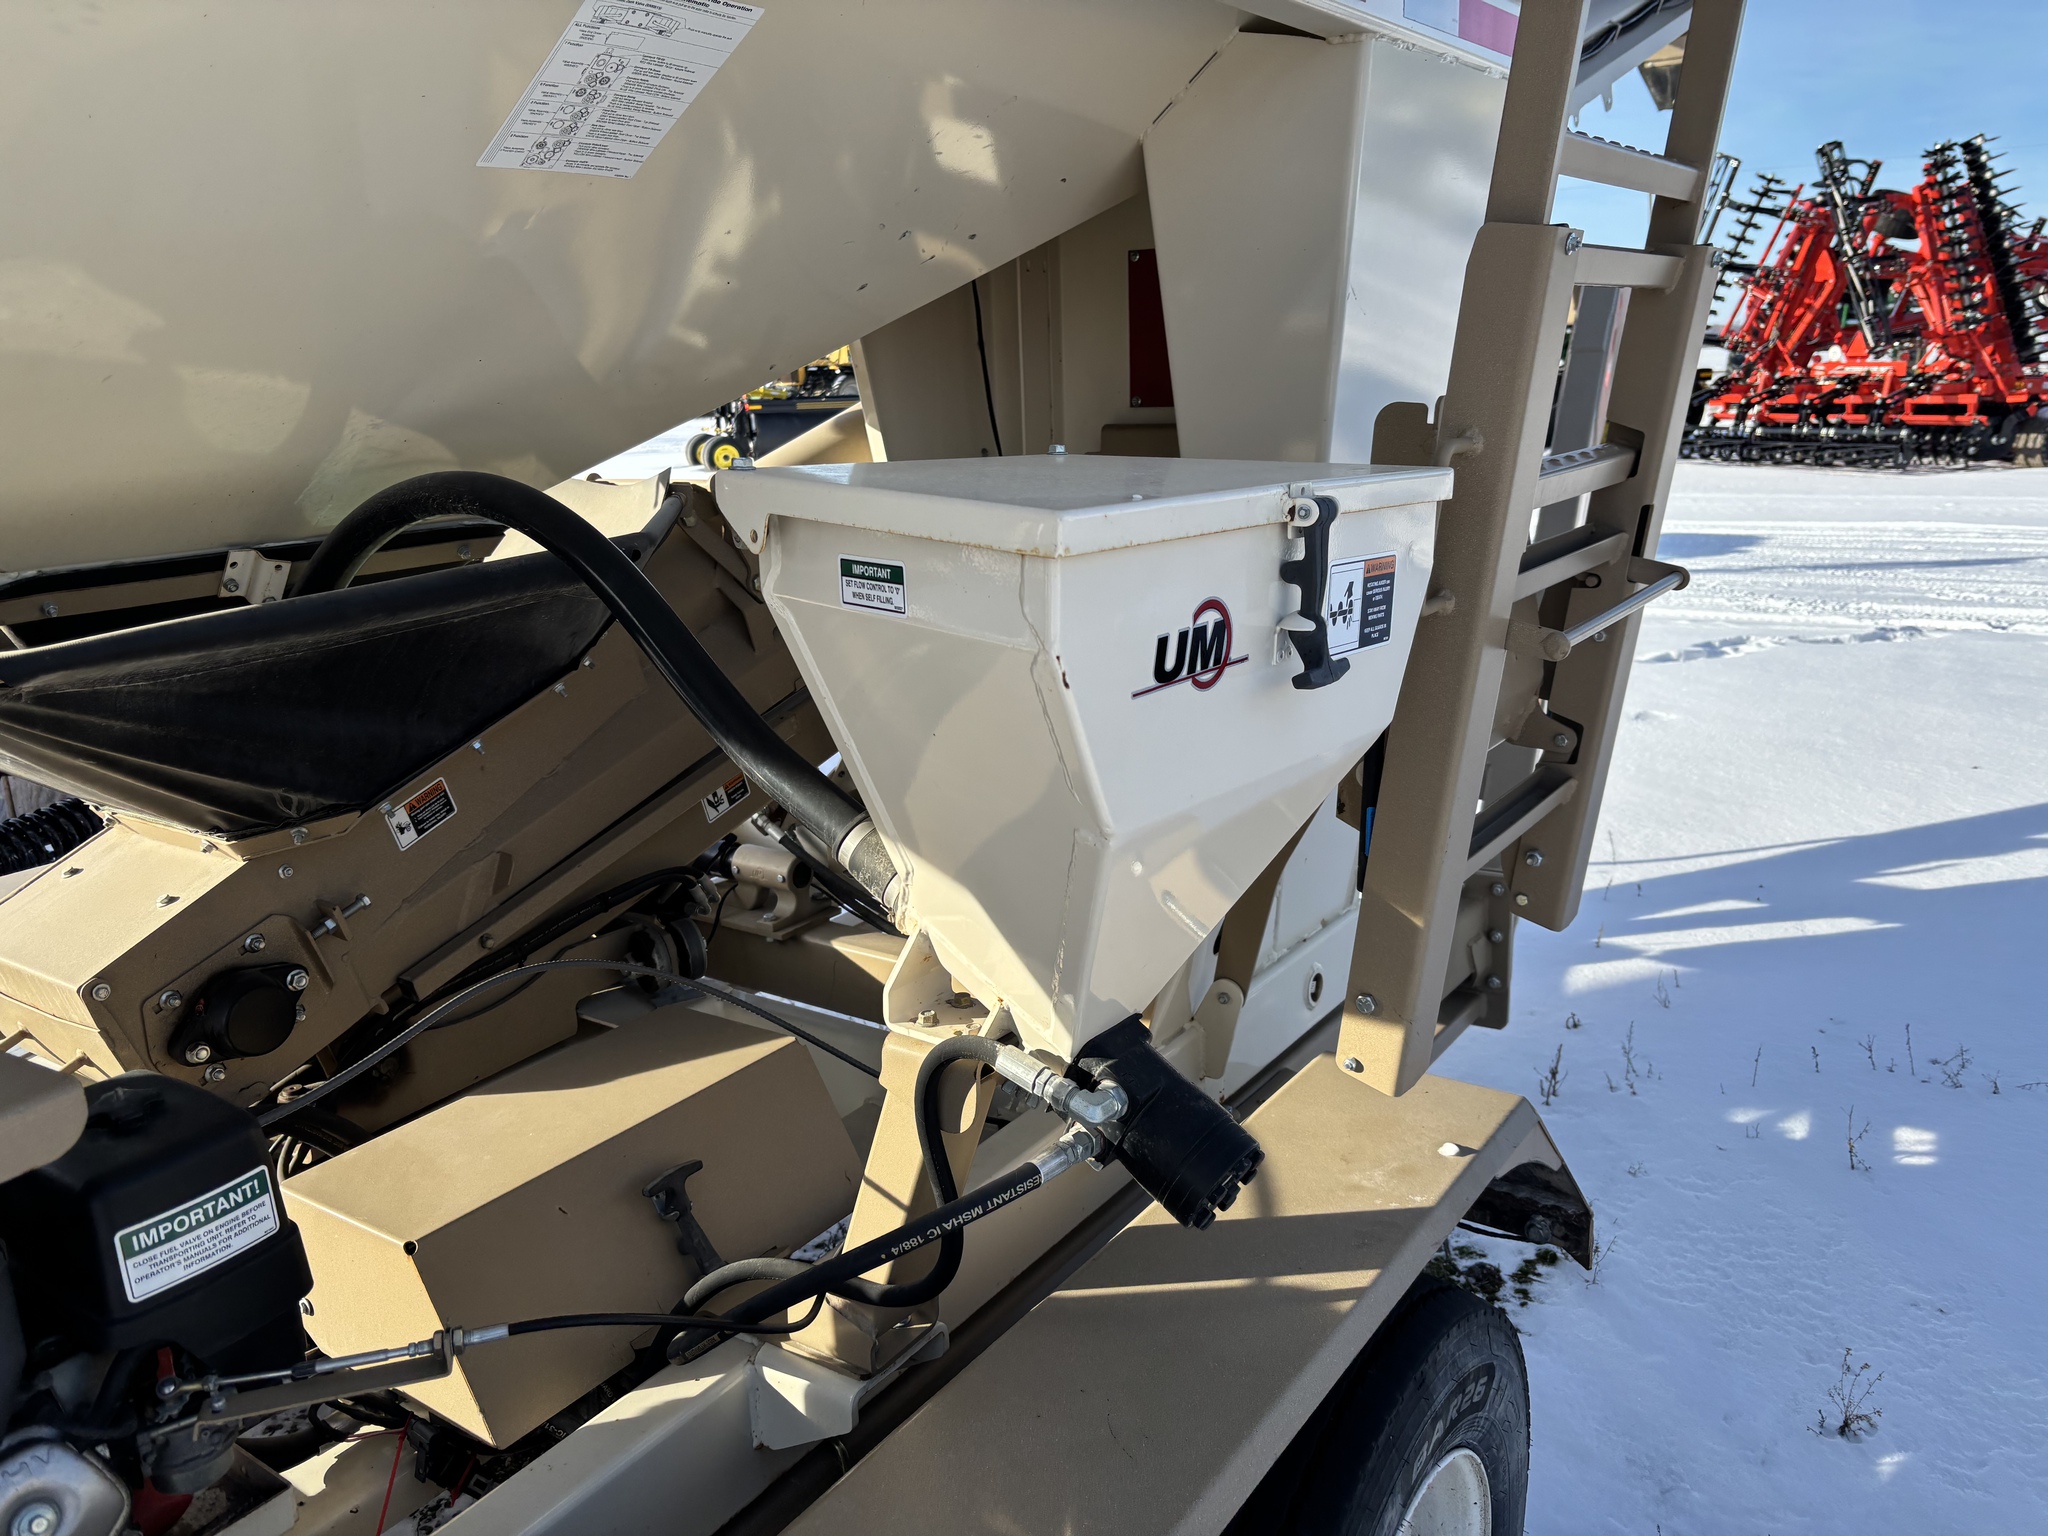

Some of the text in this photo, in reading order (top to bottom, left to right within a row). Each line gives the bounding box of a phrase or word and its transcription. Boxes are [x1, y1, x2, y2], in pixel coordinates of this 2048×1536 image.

[722, 1, 753, 13] Operation
[851, 563, 891, 579] IMPORTANT
[1370, 559, 1395, 573] WARNING
[845, 579, 853, 588] SET
[854, 579, 866, 590] FLOW
[866, 582, 887, 594] CONTROL
[887, 585, 895, 594] TO
[852, 591, 895, 606] WHEN SELF FILLING.
[1154, 618, 1227, 684] UM
[415, 783, 443, 806] WARNING
[131, 1179, 260, 1252] IMPORTANT!
[942, 1208, 983, 1231] MSHA
[133, 1200, 267, 1269] CLOSE FUEL VALVE ON ENGINE BEFORE
[148, 1240, 206, 1270] TRANSPORTING
[225, 1220, 247, 1235] REFER
[248, 1214, 257, 1225] TO
[926, 1227, 942, 1240] IC
[134, 1213, 272, 1285] OPERATOR'S MANUALS FOR ADDITIONAL
[183, 1243, 234, 1271] INFORMATION.
[890, 1235, 925, 1256] 188/4
